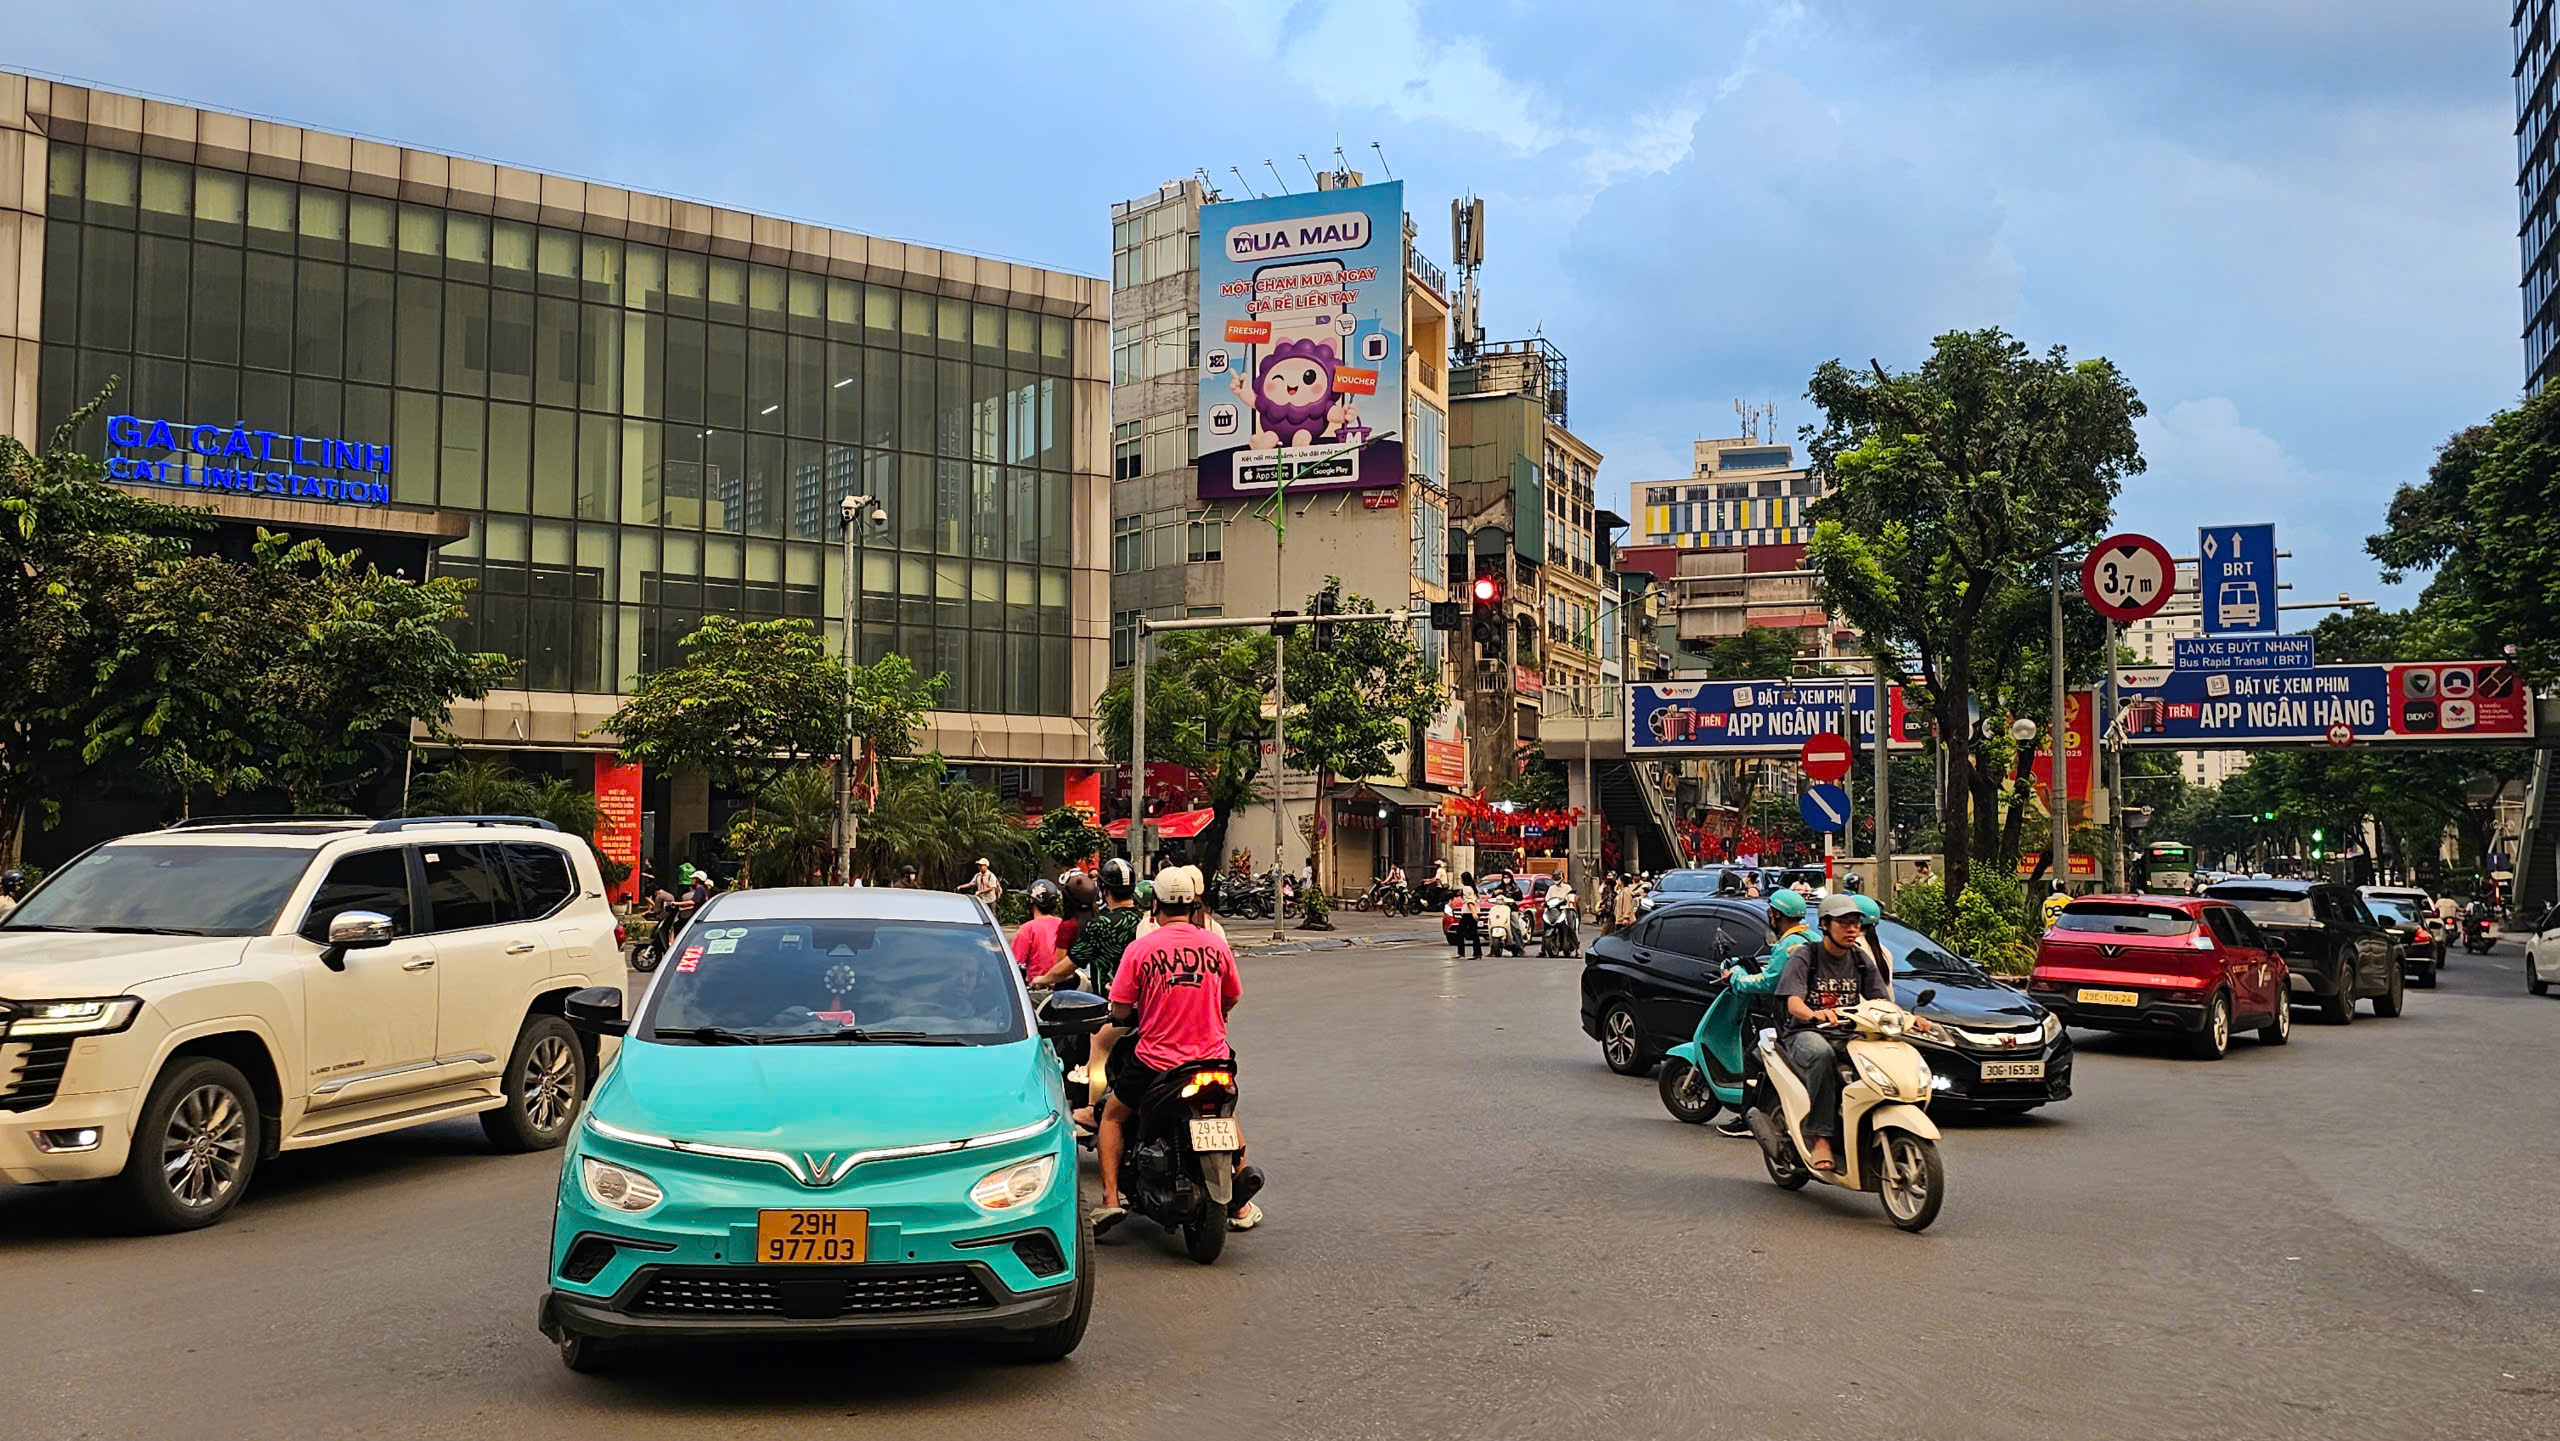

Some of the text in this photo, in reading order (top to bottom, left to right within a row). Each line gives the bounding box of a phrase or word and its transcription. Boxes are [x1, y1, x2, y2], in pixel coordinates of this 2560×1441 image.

[1233, 222, 1359, 253] MUA MAU
[1220, 266, 1378, 298] MỘT CHẠM MUA NGAY
[1246, 296, 1271, 313] GIÁ
[1274, 292, 1293, 310] RẺ
[1331, 288, 1359, 304] TAY
[1228, 326, 1268, 336] FREESHIP
[1336, 375, 1376, 387] VOUCHER
[109, 415, 391, 474] GA CÁT LINH
[1255, 471, 1289, 480] App Stre
[1313, 467, 1335, 475] Google
[1335, 465, 1349, 475] Play
[110, 457, 390, 505] CAT LINH STATION
[2223, 562, 2253, 576] BRT
[2179, 638, 2309, 655] LÀN XE BUÝT NHANH
[2179, 655, 2309, 669] Bus Rapid Transit (BRT)
[2235, 675, 2350, 698] ĐẶT VÉ XEM PHIM
[1758, 688, 1780, 708] ĐẶT
[1799, 689, 1825, 704] XEM
[1827, 689, 1856, 704] PHM
[2168, 704, 2193, 719] TRÊN
[2199, 693, 2375, 729] APP NGÂN HÀNG
[2406, 713, 2427, 721] BIDV
[1700, 714, 1721, 727] TRÊN
[1727, 712, 1764, 737] APP
[1768, 706, 1820, 736] NGÂN
[2064, 749, 2082, 757] 025
[1118, 769, 1133, 778] QUÁ
[676, 945, 705, 973] TAXI
[1986, 1064, 2040, 1076] 30G-165.38
[1195, 1135, 1235, 1149] 214.41
[790, 1213, 837, 1235] 29H
[769, 1239, 854, 1262] 977.03
